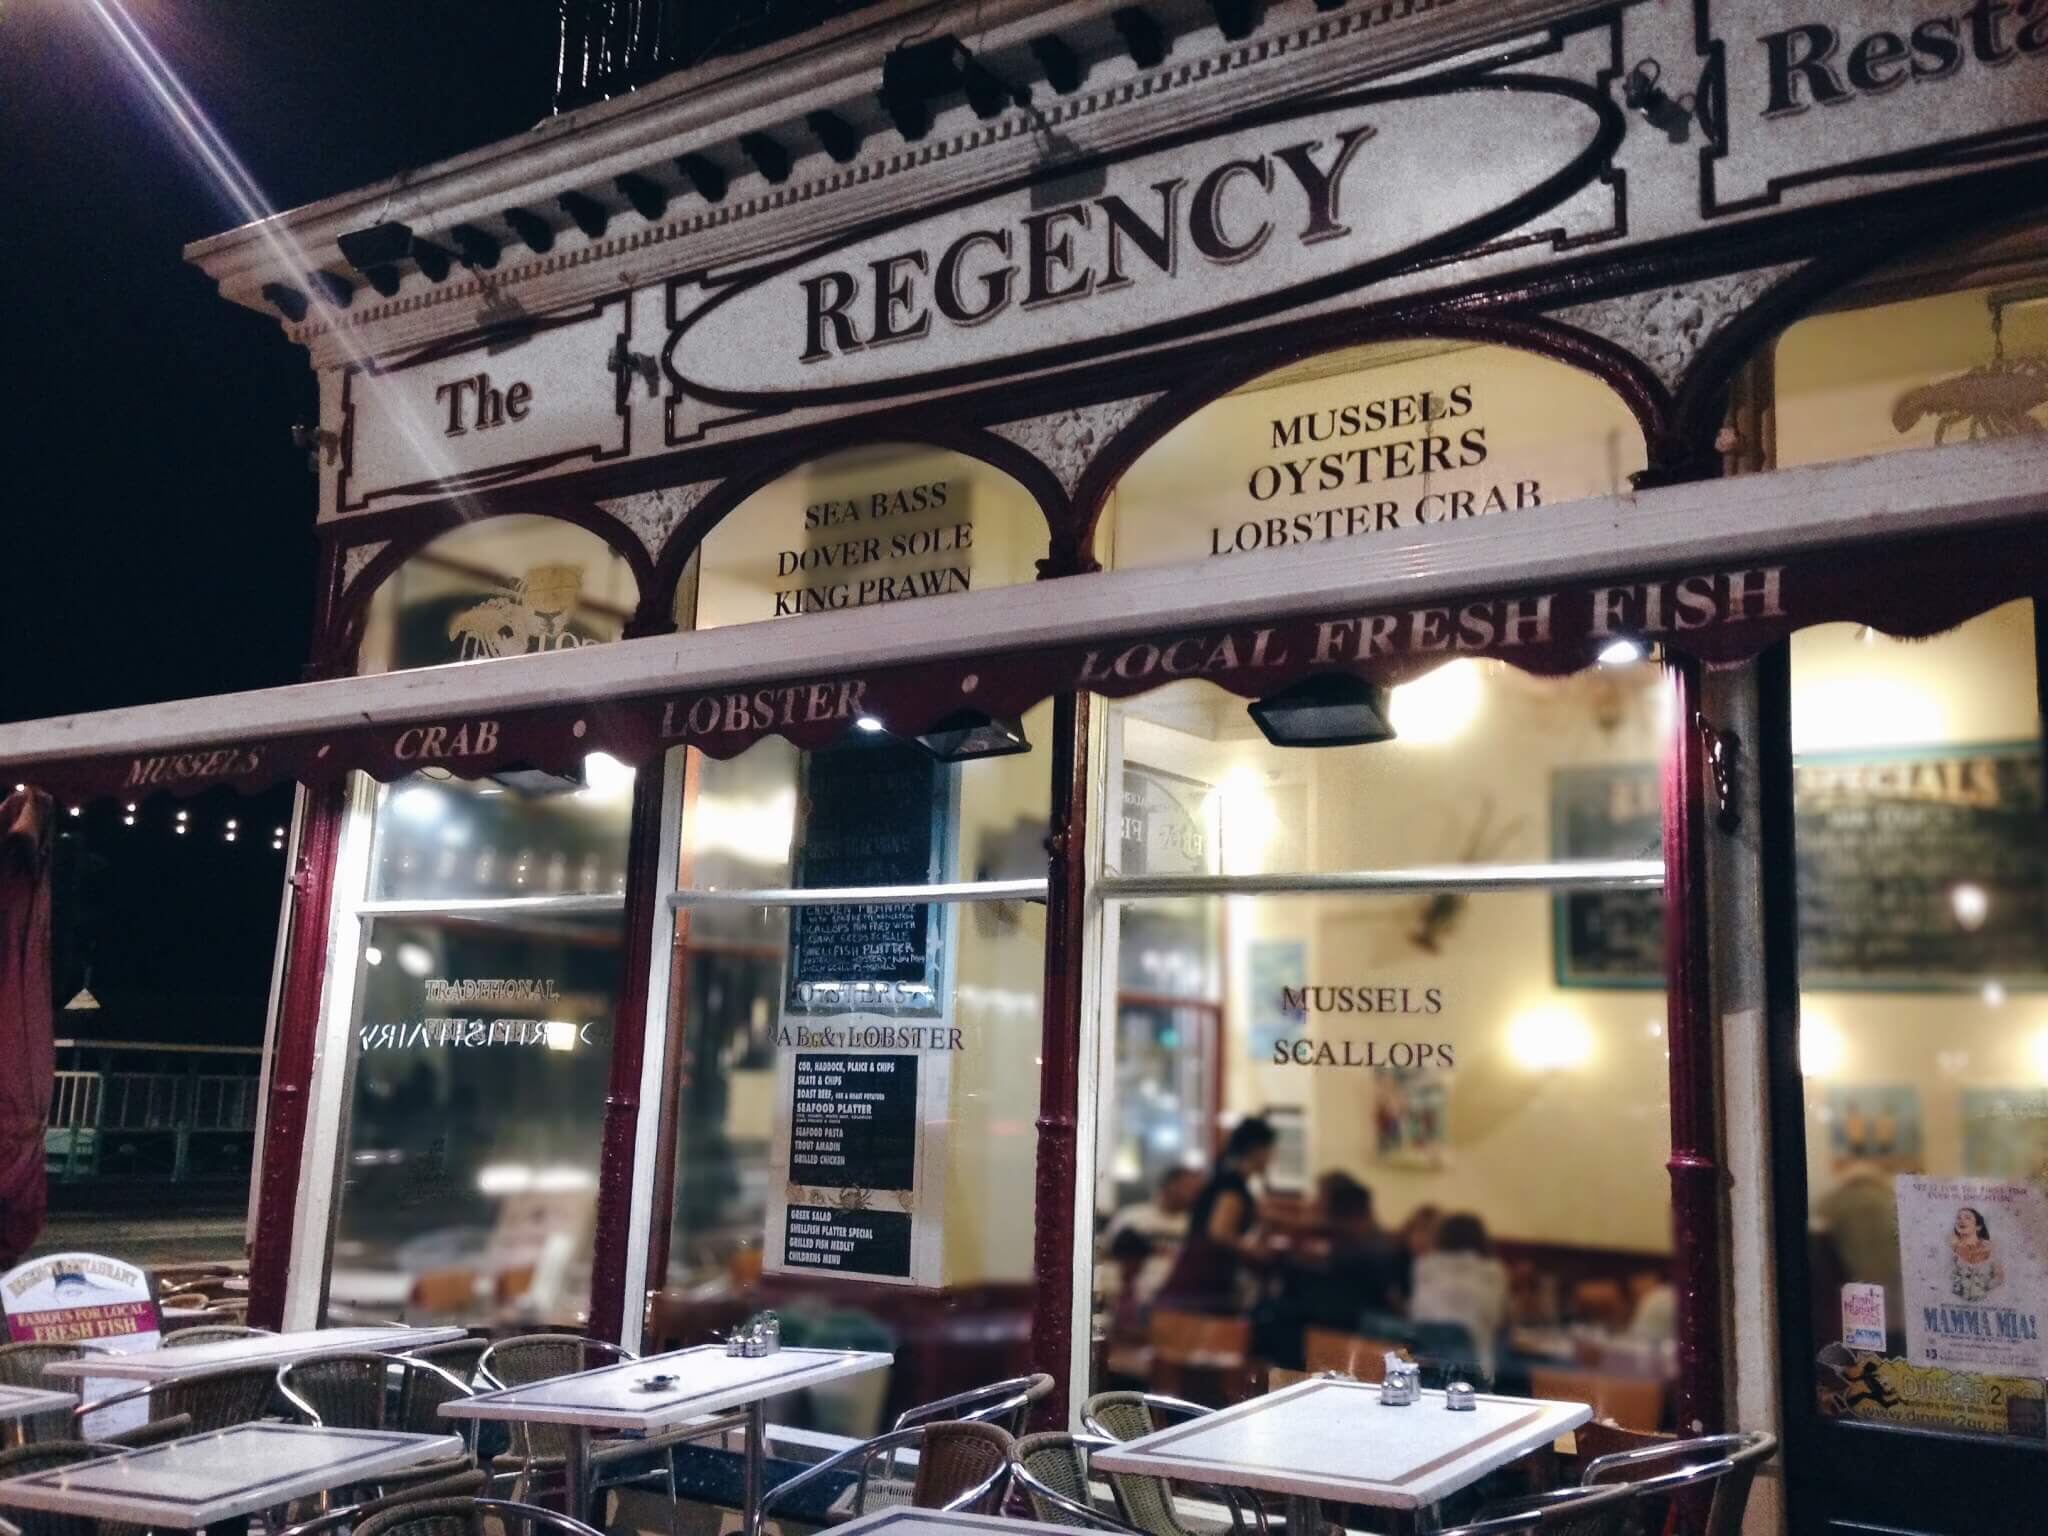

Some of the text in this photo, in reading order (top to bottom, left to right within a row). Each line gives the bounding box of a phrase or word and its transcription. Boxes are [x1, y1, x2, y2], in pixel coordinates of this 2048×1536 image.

[800, 125, 1377, 363] REGENCY
[436, 373, 532, 437] The
[1271, 384, 1473, 449] MUSSELS
[1249, 427, 1488, 500] OYSTERS
[804, 481, 947, 530] SEA BASS
[1209, 479, 1541, 556] LOBSTER CRAB
[777, 522, 973, 577] DOVER SOLE
[774, 567, 972, 617] KING PRAWN
[1076, 565, 1788, 683] LOCAL FRESH FISH
[661, 679, 868, 738] LOBSTER
[394, 720, 500, 761] CRAB
[125, 744, 267, 787] MUSSELS
[1282, 986, 1442, 1014] MUSSELS
[848, 1026, 965, 1050] LOBSTER
[876, 1062, 895, 1072] CHIPS
[1273, 1039, 1454, 1067] SCALLOPS
[797, 1075, 816, 1086] SKATE
[824, 1075, 842, 1086] CHIPS
[797, 1089, 816, 1099] ROAST
[796, 1103, 872, 1114] SEAFOOD PLATTER
[795, 1127, 844, 1138] SEAFOOD PASTA
[812, 1211, 832, 1221] SALAD
[821, 1225, 847, 1237] PLATTER
[848, 1227, 873, 1239] SPECIAL
[16, 1310, 74, 1326] FAMOUS
[103, 1303, 147, 1319] LOCAL
[32, 1316, 138, 1342] FRESH FISH
[1923, 1307, 1992, 1336] MAMMA
